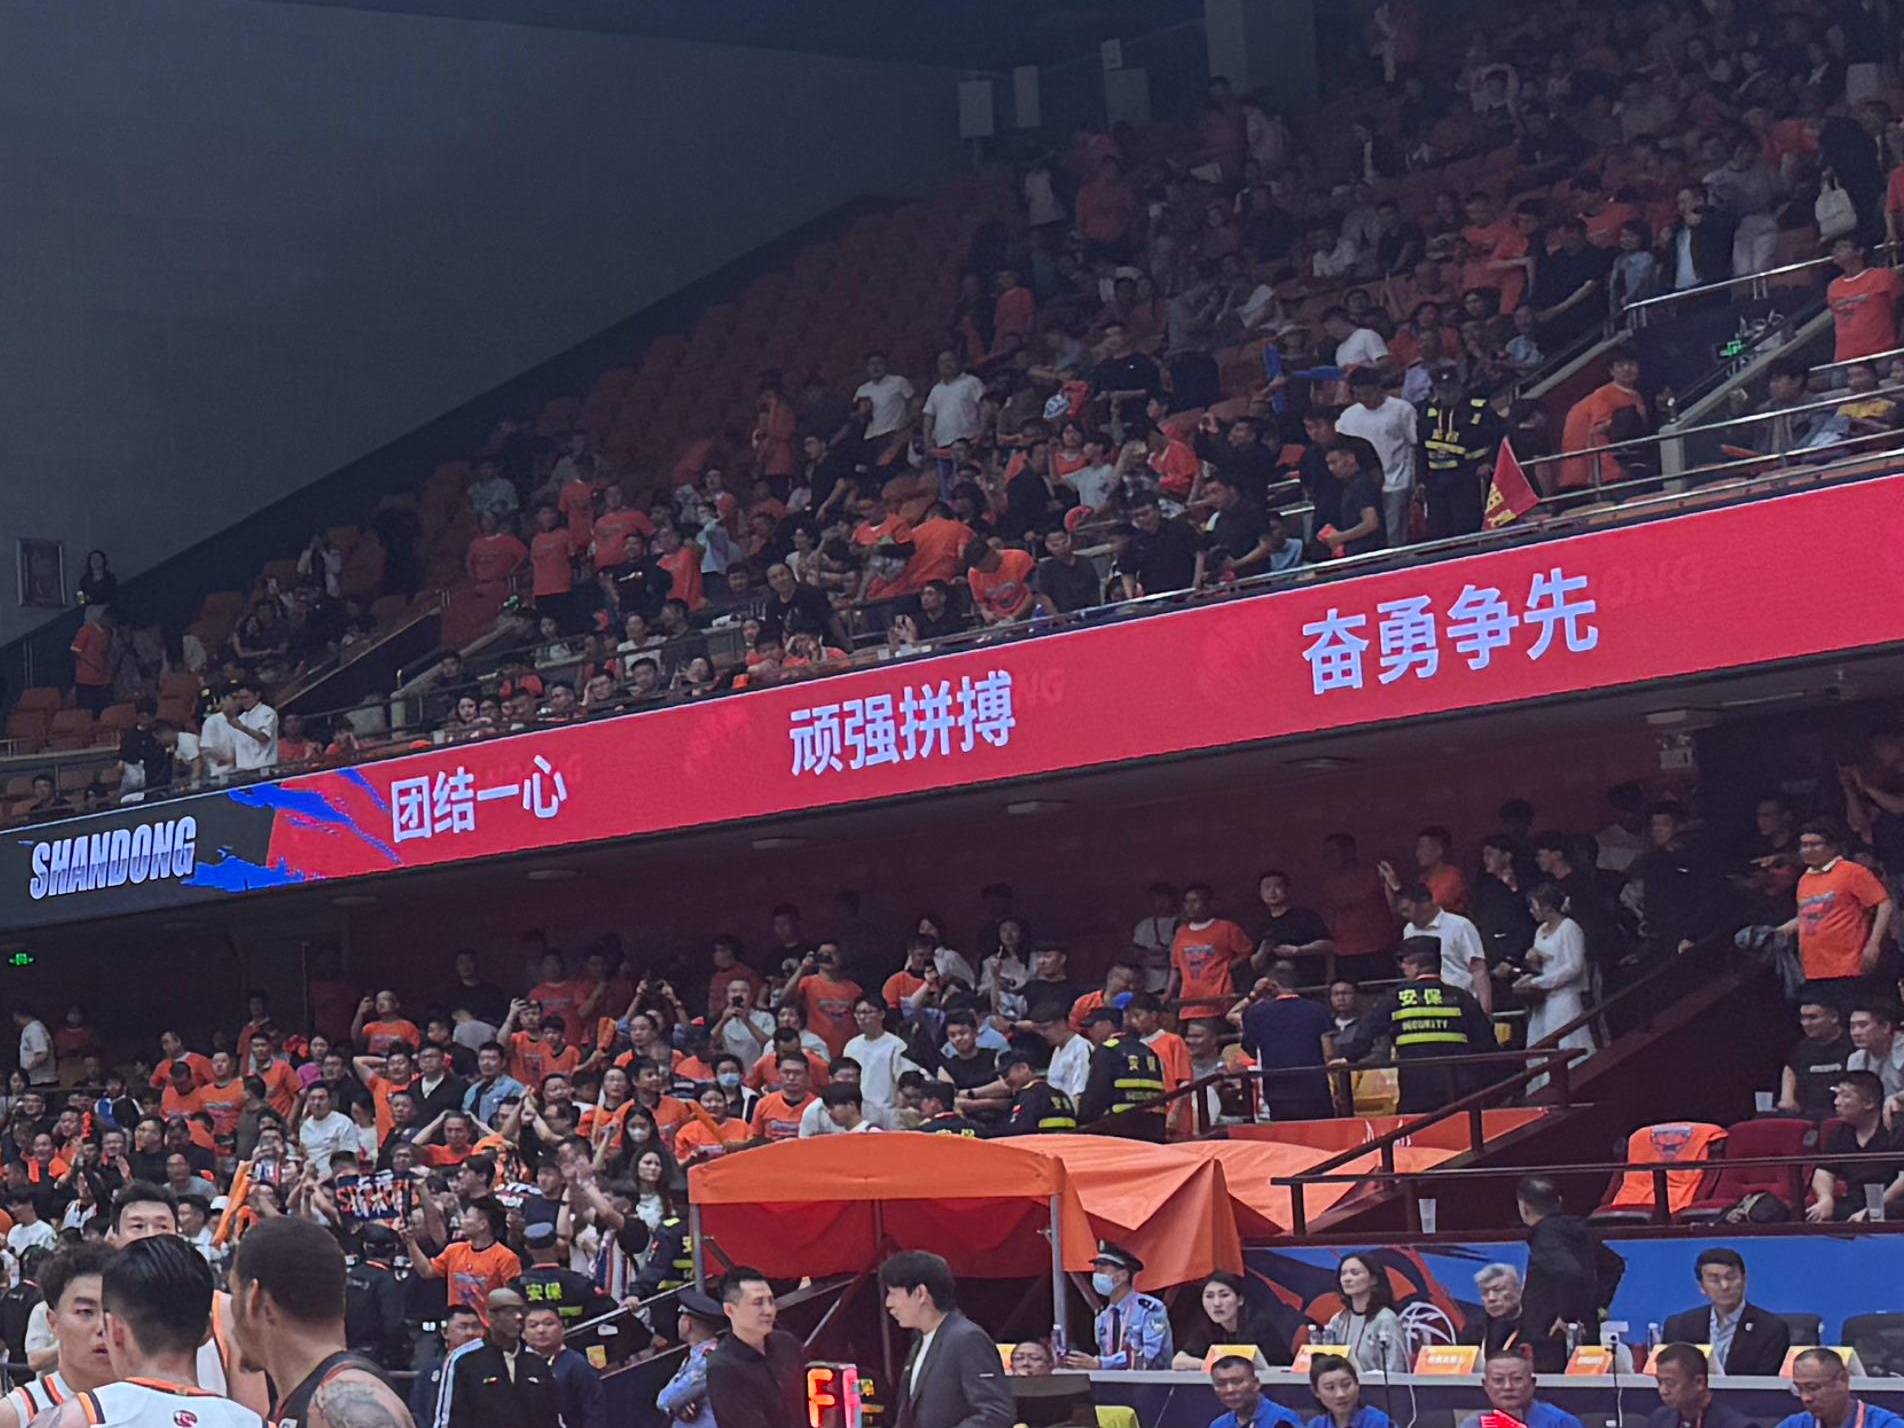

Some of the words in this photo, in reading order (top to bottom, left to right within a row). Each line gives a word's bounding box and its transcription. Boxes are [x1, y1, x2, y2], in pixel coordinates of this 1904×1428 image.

[1303, 567, 1598, 695] 奋勇争先
[789, 669, 1015, 777] 顽强拼搏
[391, 756, 568, 843] 团结一心
[30, 816, 198, 901] SHANDONG
